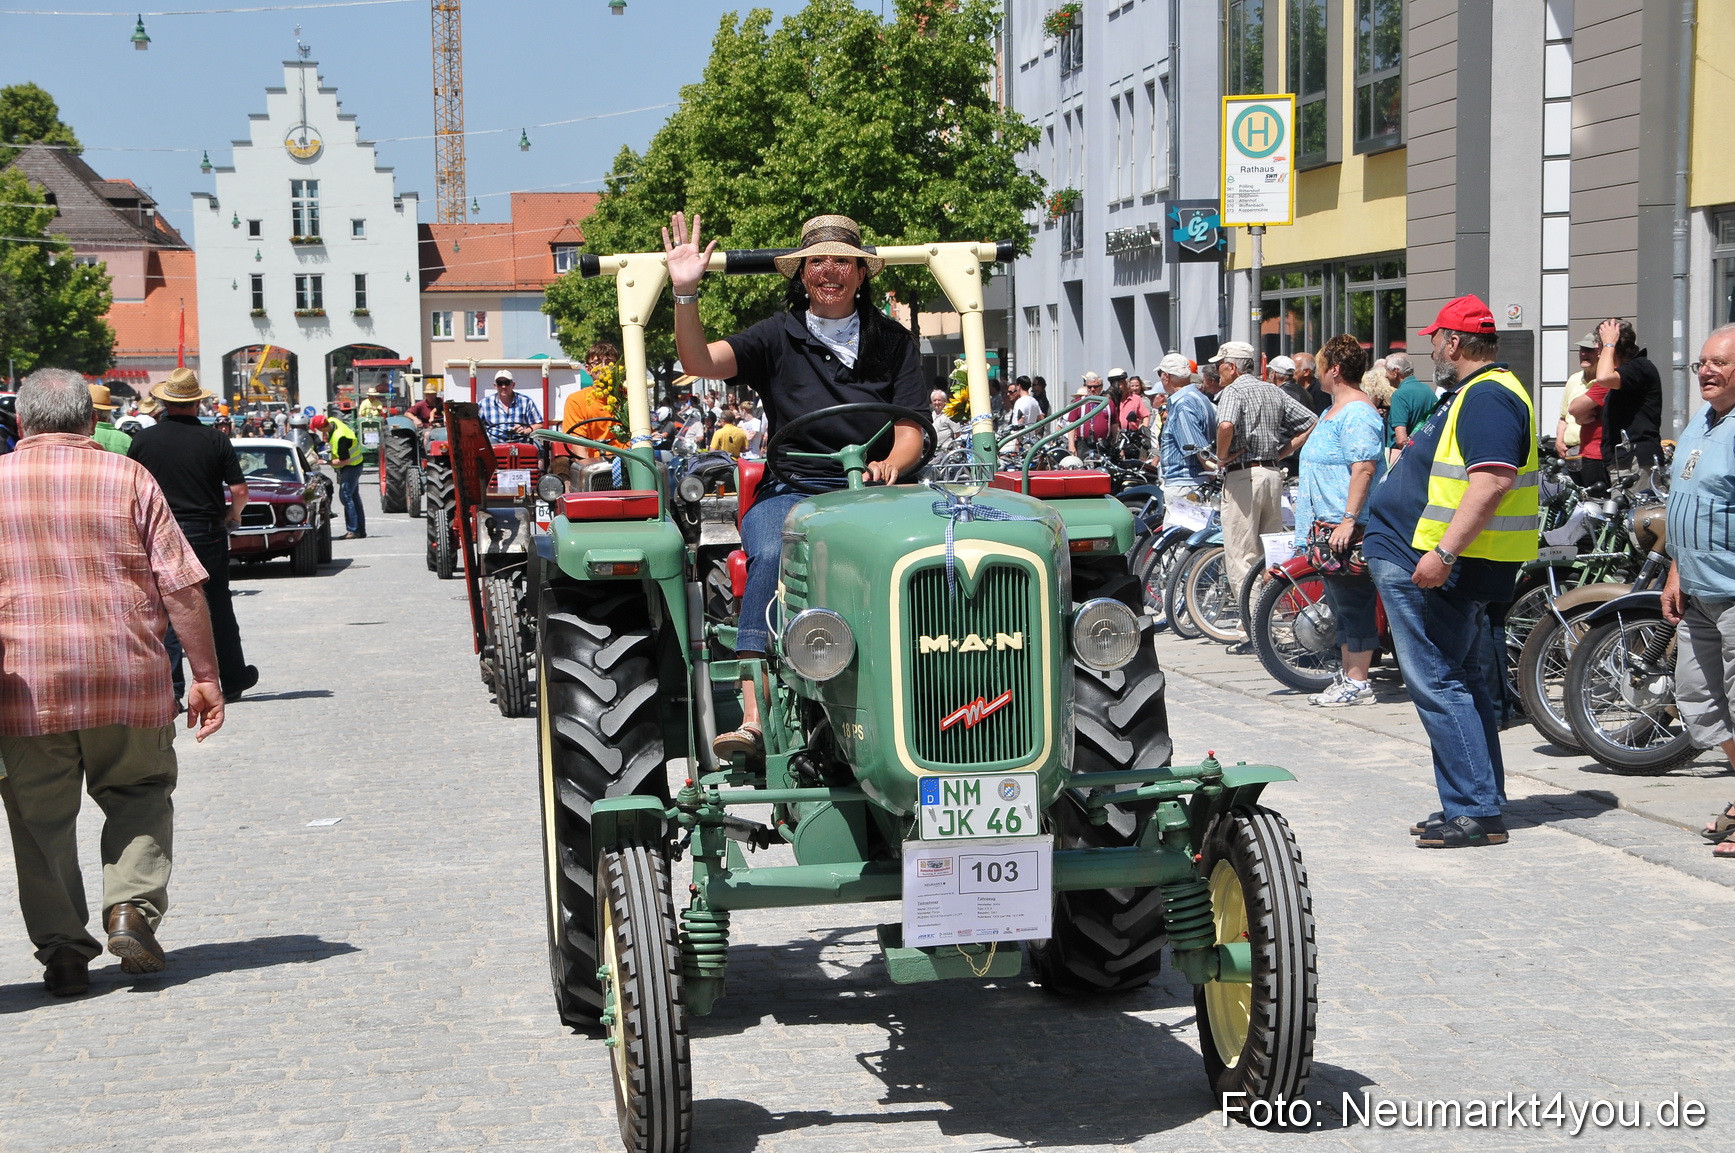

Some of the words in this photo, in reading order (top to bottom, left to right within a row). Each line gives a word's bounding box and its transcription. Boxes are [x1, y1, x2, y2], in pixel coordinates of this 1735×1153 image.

[1240, 165, 1275, 173] Rathaus
[842, 722, 851, 738] 18
[852, 723, 864, 740] PS
[927, 795, 935, 803] D
[943, 778, 981, 806] NM
[938, 808, 975, 836] JK
[987, 807, 1022, 834] 46
[971, 860, 1019, 882] 103
